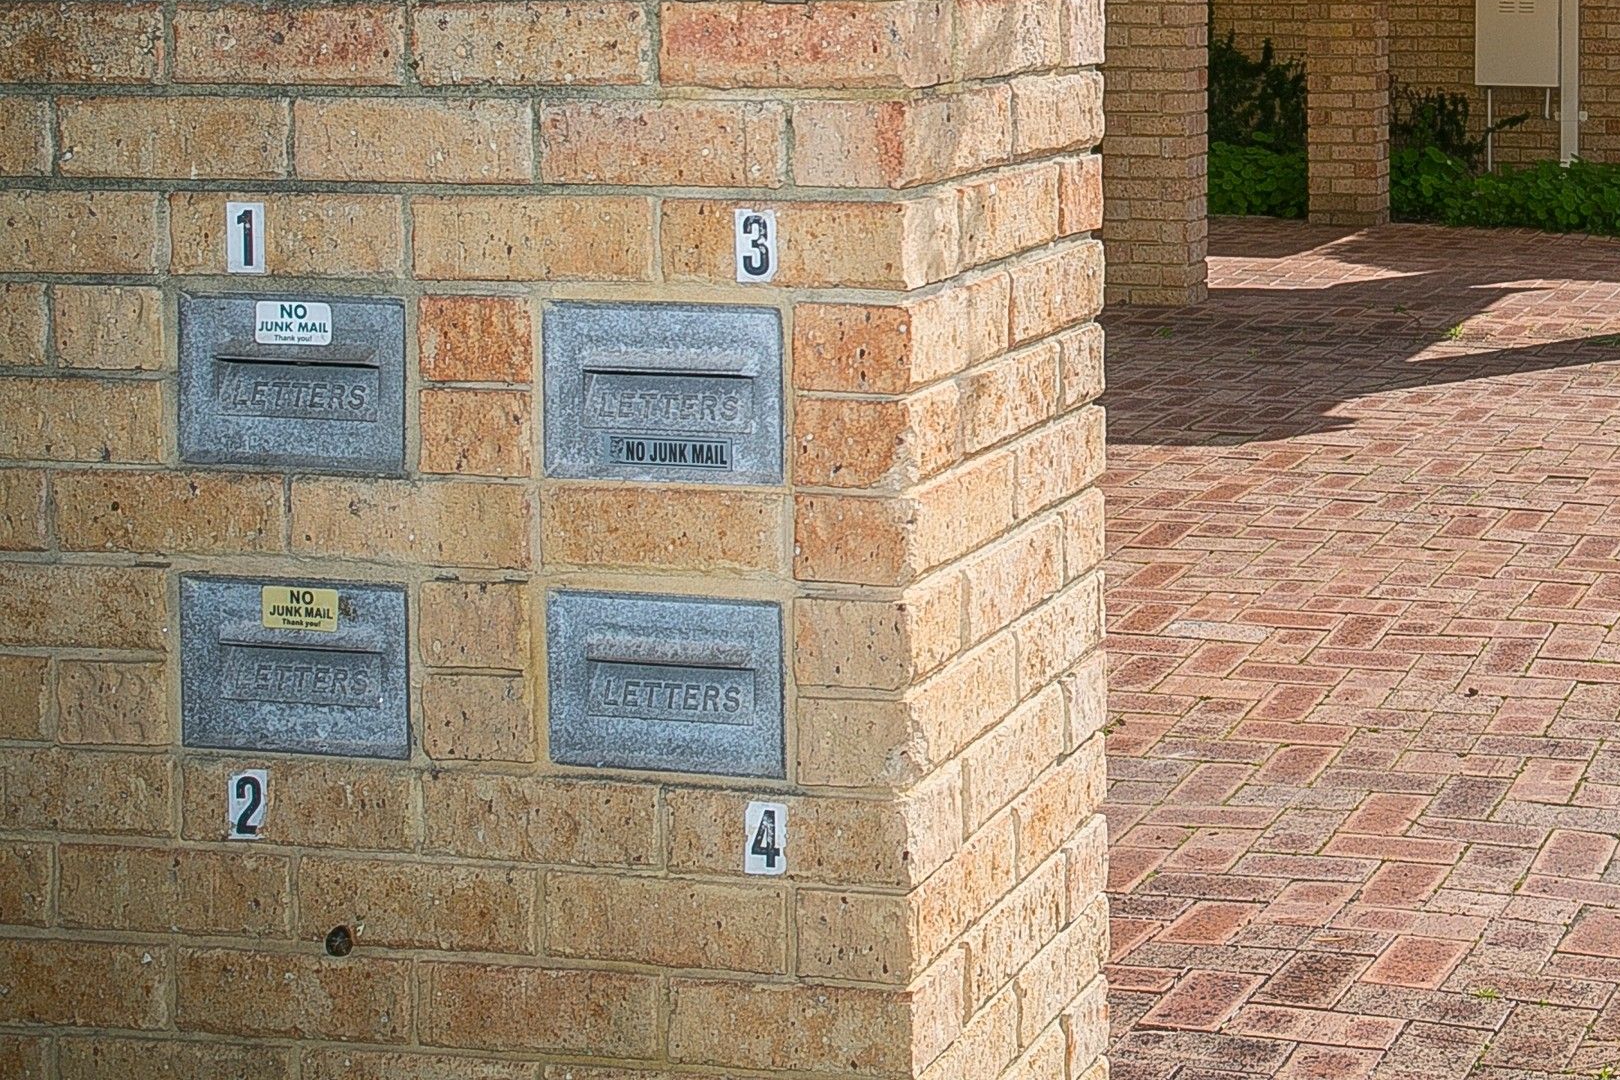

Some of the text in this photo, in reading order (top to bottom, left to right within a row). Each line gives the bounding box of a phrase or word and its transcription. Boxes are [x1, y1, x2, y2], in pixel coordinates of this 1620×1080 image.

[236, 208, 254, 267] 1
[742, 215, 770, 277] 3
[258, 321, 328, 333] JUNK MAIL
[280, 304, 307, 320] NO
[232, 379, 366, 411] LETTERS
[599, 391, 739, 421] LETTERS
[626, 441, 728, 465] NO JUNK MAIL
[269, 605, 333, 619] JUNK MAIL
[290, 590, 314, 605] NO
[282, 618, 304, 626] Thank
[234, 664, 369, 696] LETTERS
[602, 678, 742, 714] LETTERS
[235, 775, 262, 836] 2
[750, 809, 781, 869] 4
